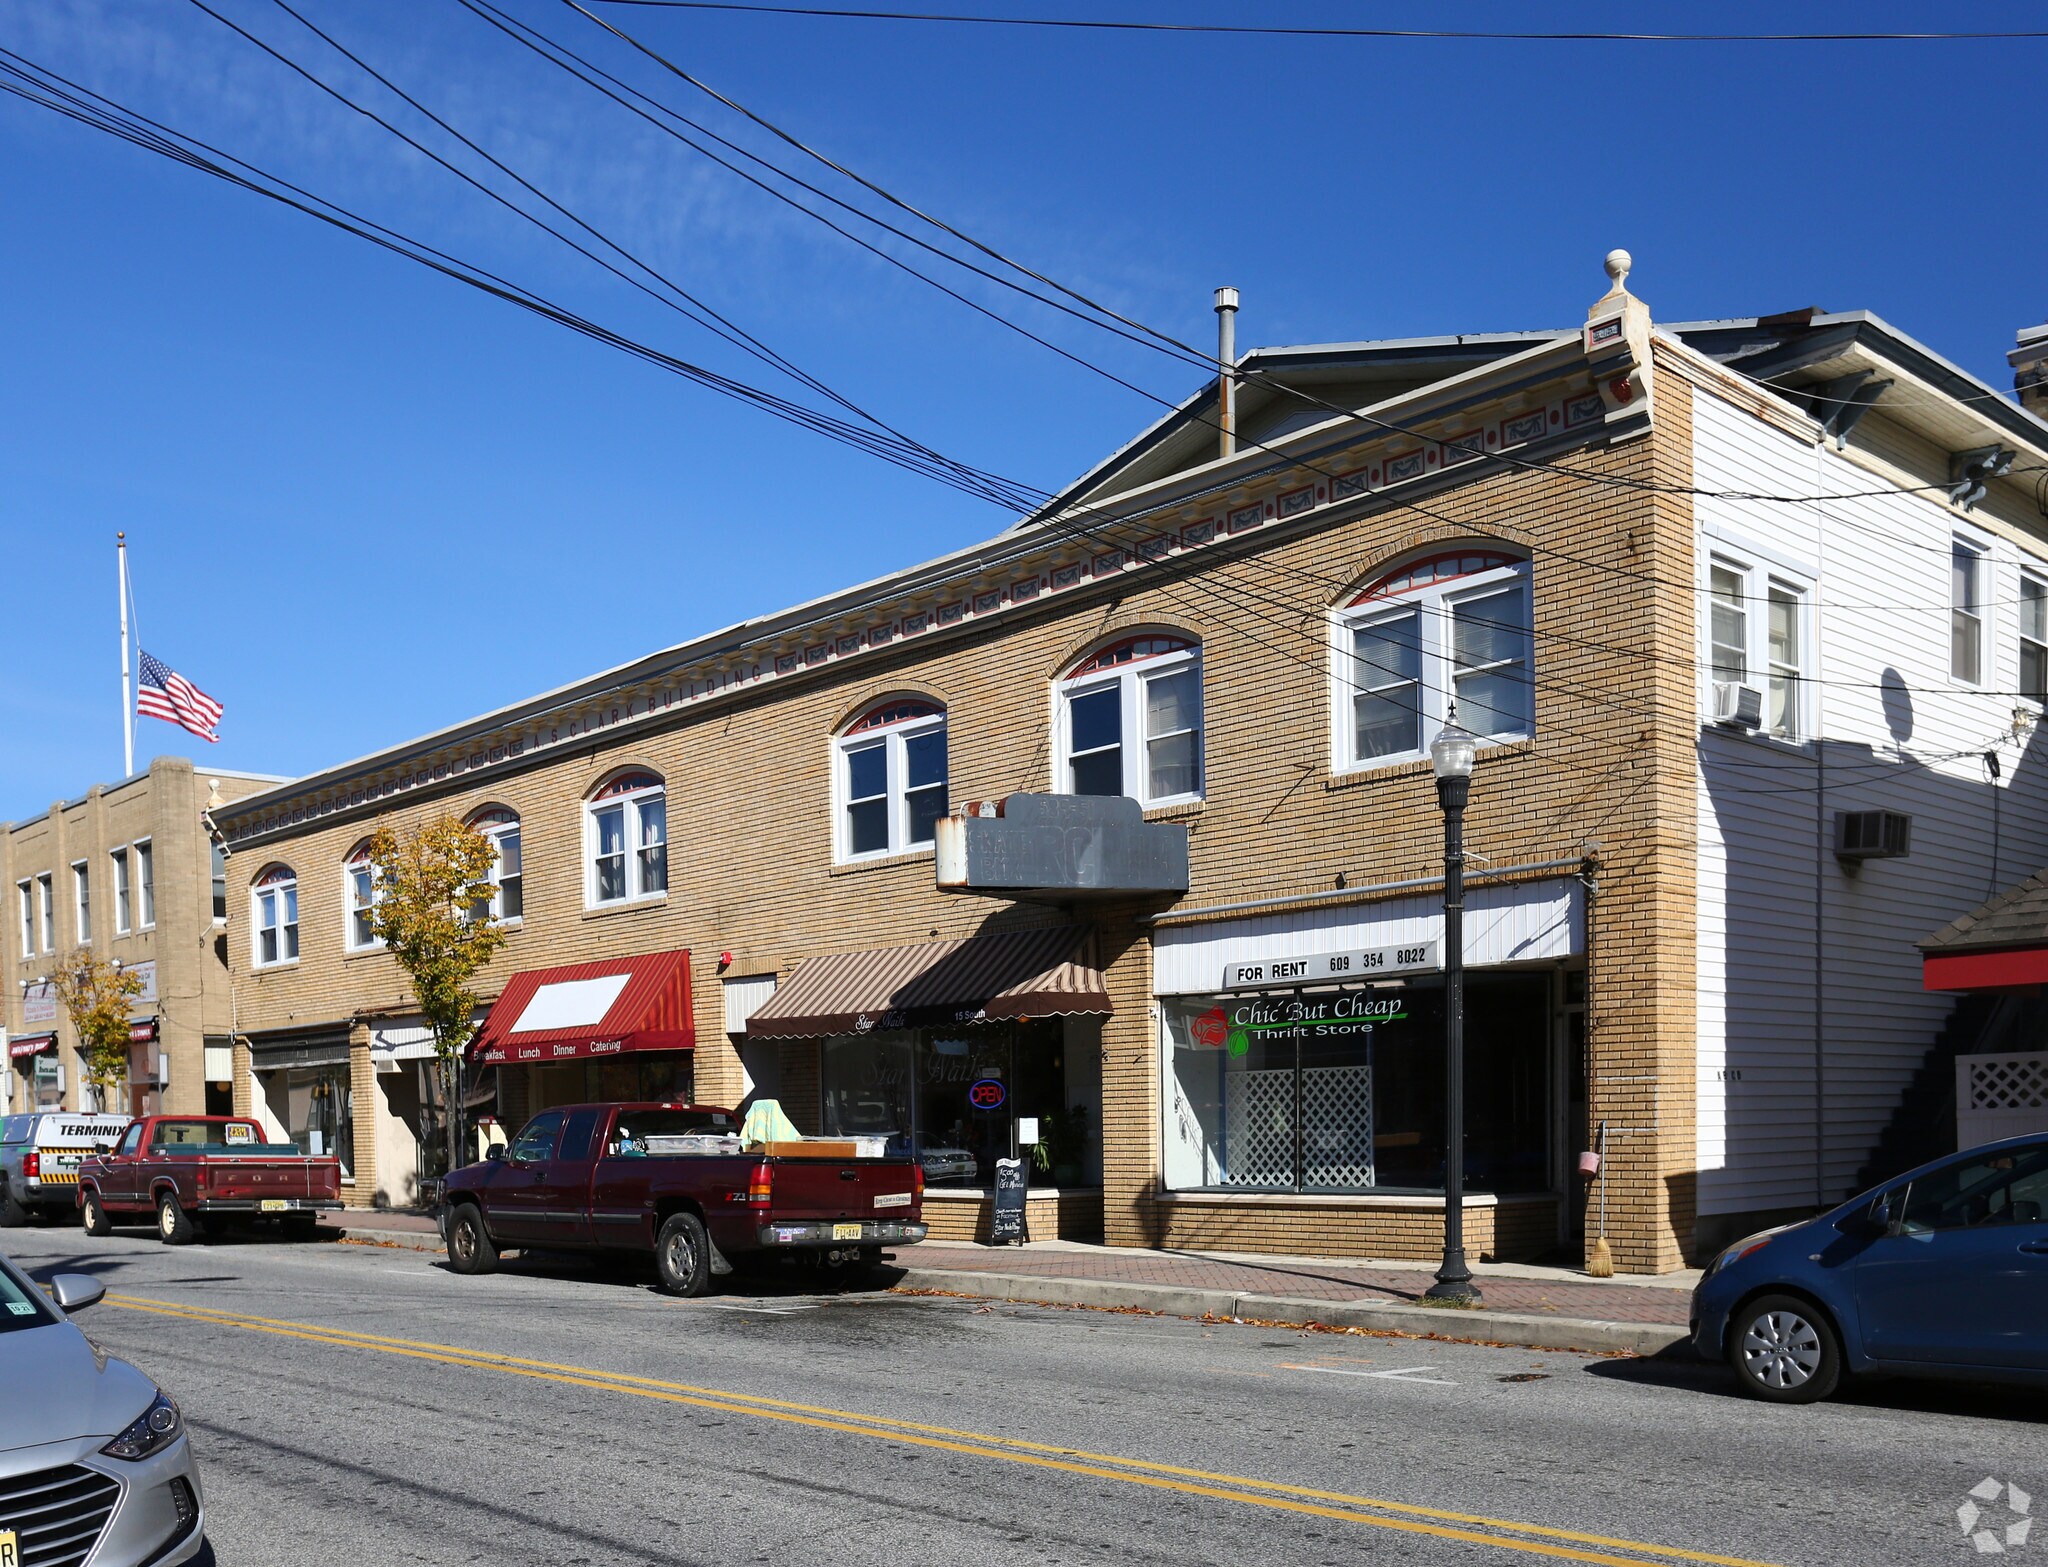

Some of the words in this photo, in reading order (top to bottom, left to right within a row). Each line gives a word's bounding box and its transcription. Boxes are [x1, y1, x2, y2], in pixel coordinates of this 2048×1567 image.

[569, 703, 634, 738] CLARK
[648, 665, 762, 714] BUILDING
[1237, 967, 1263, 981] FOR
[1272, 961, 1308, 978] RENT
[1330, 957, 1350, 971] 609
[1363, 953, 1384, 967] 354
[1397, 948, 1426, 964] 8022
[855, 1014, 875, 1030] Star
[877, 1011, 906, 1028] Nails
[955, 1012, 963, 1021] 15
[964, 1008, 986, 1020] South
[1286, 1002, 1327, 1021] But
[1334, 992, 1402, 1024] Cheap
[1252, 1026, 1309, 1040] Thrift
[1315, 1022, 1373, 1036] Store
[473, 1049, 506, 1061] Breakfast
[518, 1047, 541, 1059] Lunch
[553, 1045, 577, 1056] Dinner
[589, 1039, 621, 1052] Catering
[917, 1051, 984, 1084] Nails
[972, 1086, 1003, 1103] OPEN
[60, 1125, 126, 1136] TERMINIX
